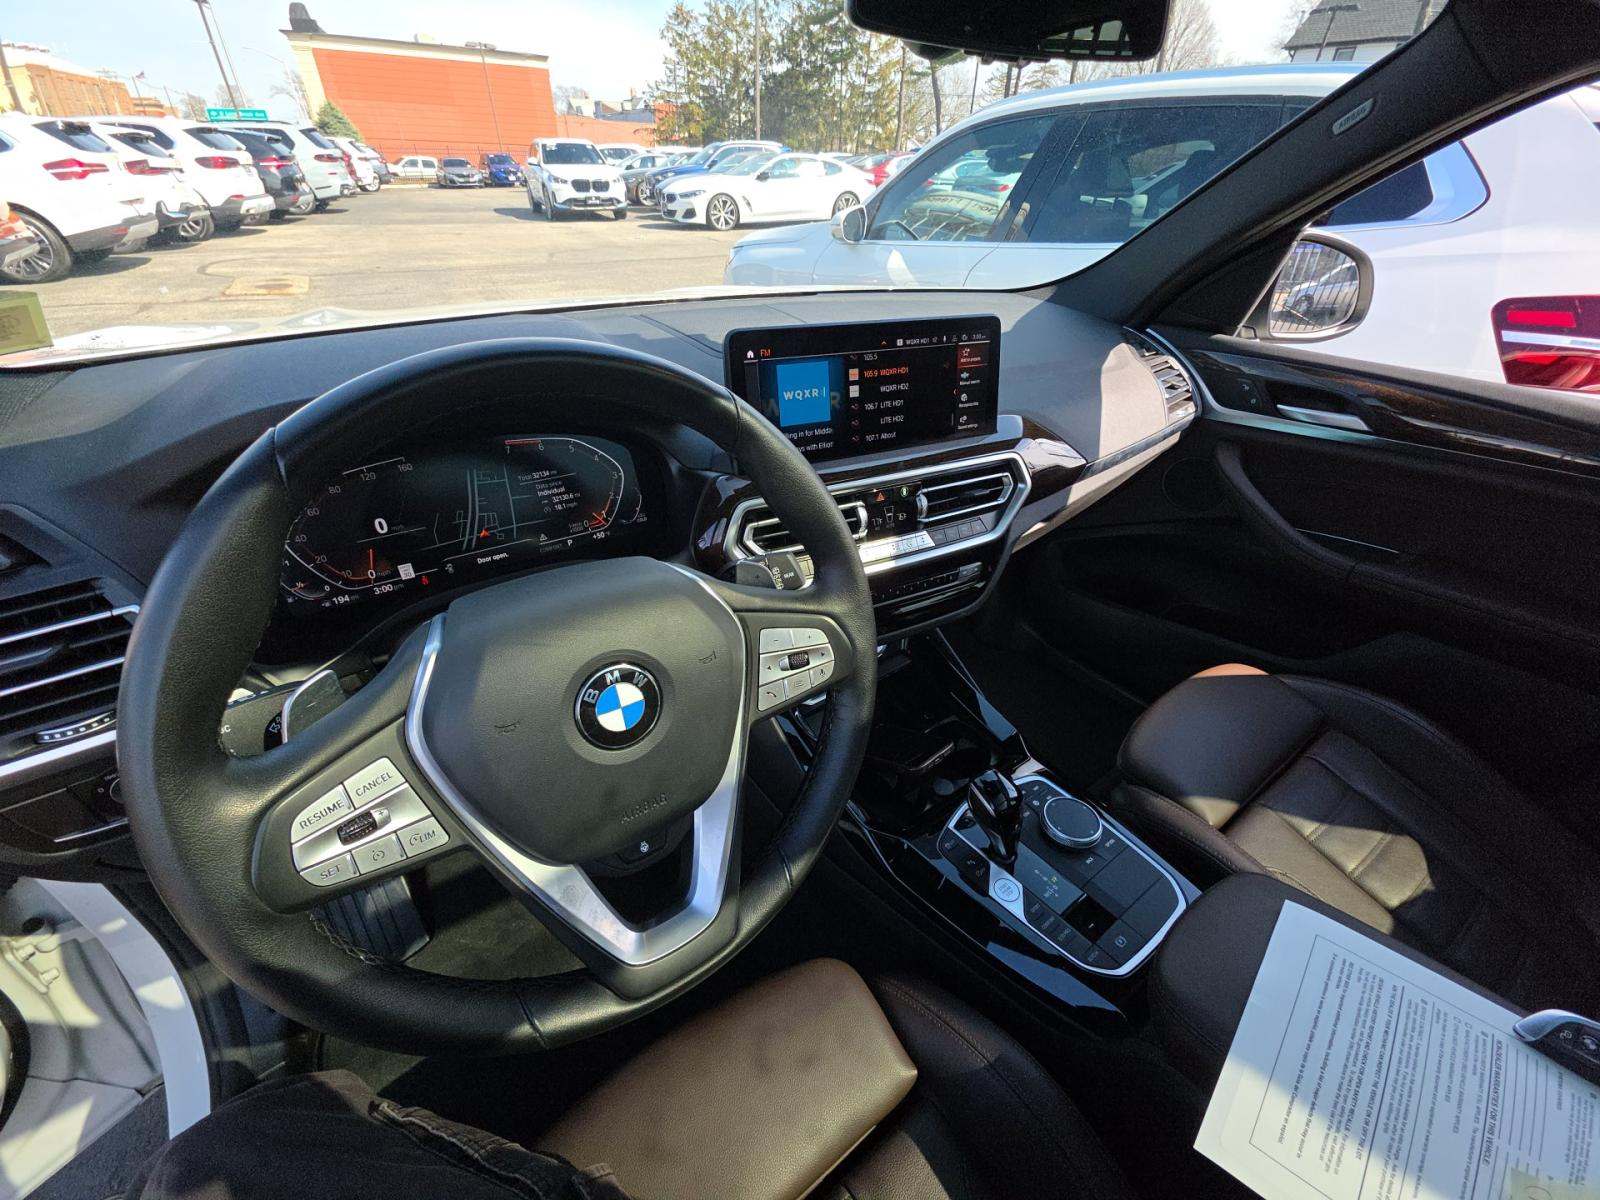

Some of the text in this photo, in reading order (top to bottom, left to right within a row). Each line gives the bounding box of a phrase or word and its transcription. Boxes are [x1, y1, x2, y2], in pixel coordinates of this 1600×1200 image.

[760, 349, 771, 357] FM
[864, 370, 878, 378] 105.9
[880, 368, 897, 376] WQXR
[783, 388, 819, 401] WQXR
[864, 402, 878, 410] 106.7
[880, 401, 891, 409] LITE
[893, 415, 905, 423] HD2
[538, 442, 544, 451] 6
[569, 445, 575, 453] 5
[398, 464, 413, 473] 160
[360, 472, 376, 481] 120
[532, 470, 550, 479] 32134
[329, 485, 341, 494] 80
[537, 486, 565, 497] Individual
[552, 492, 574, 503] 32130.6
[307, 507, 320, 516] 60
[374, 518, 388, 534] 0
[584, 520, 589, 528] 0
[295, 534, 307, 543] 40
[593, 532, 605, 540] +50
[567, 539, 573, 547] P
[315, 555, 327, 564] 20
[477, 552, 509, 565] Door open.
[343, 569, 352, 578] 10
[368, 569, 376, 579] 0
[373, 584, 393, 595] 3:00
[332, 594, 350, 605] 194
[584, 670, 648, 704] BMW
[355, 771, 392, 797] CANCEL
[299, 799, 345, 829] RESUME
[419, 830, 436, 844] LIM
[320, 863, 341, 880] SET
[1366, 1024, 1374, 1041] REPORT
[1360, 1050, 1368, 1067] CHECK
[1374, 1059, 1382, 1079] INSPECT
[1355, 1074, 1363, 1090] OPEN
[1489, 1068, 1500, 1108] WARRANTIES
[1350, 1088, 1359, 1109] SAFETY
[1367, 1087, 1376, 1110] VEHICLE
[1285, 1090, 1297, 1119] Comprador
[1365, 1108, 1371, 1118] ON
[1488, 1107, 1497, 1122] FOR
[1363, 1116, 1369, 1127] OR
[1486, 1119, 1495, 1137] THIS
